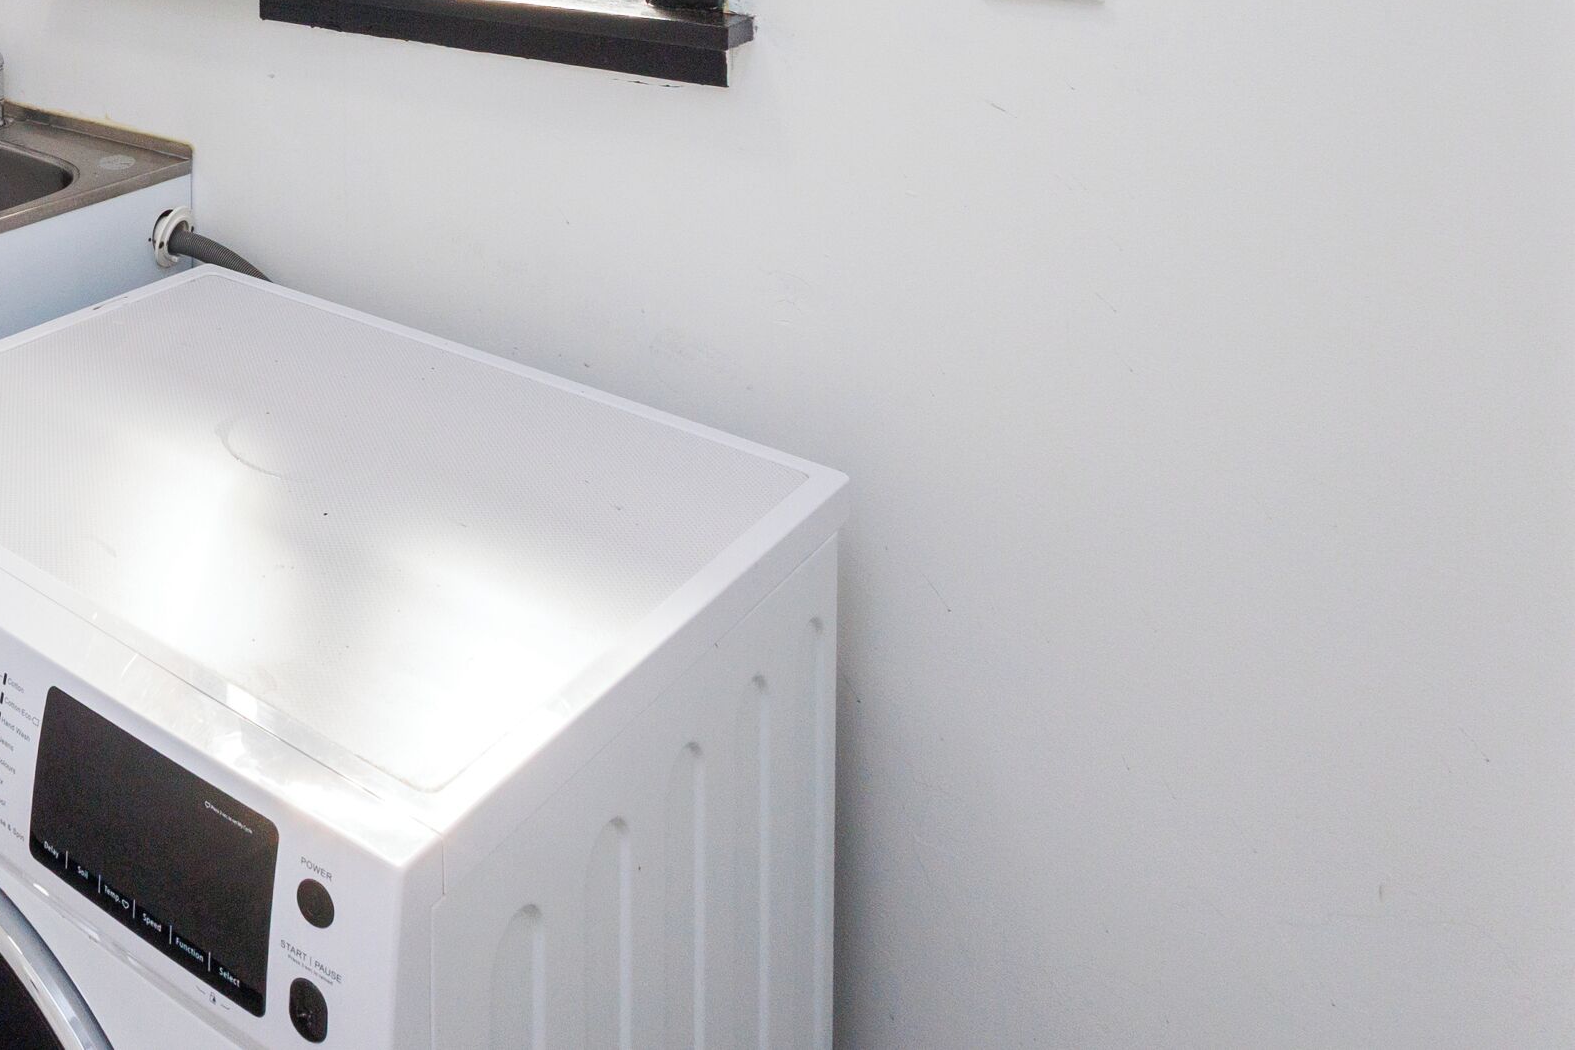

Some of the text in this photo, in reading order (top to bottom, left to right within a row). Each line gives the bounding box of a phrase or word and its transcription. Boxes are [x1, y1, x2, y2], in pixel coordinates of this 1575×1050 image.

[8, 677, 24, 693] Cotton
[5, 696, 32, 720] Cotton Eco
[2, 717, 31, 742] Hand Wash
[44, 840, 59, 859] Delay
[77, 865, 89, 880] Soil
[300, 856, 333, 882] POWER
[142, 912, 162, 933] Speed
[175, 936, 204, 963] Function
[280, 939, 307, 961] START
[314, 960, 343, 984] PAUSE
[218, 966, 241, 988] Select
